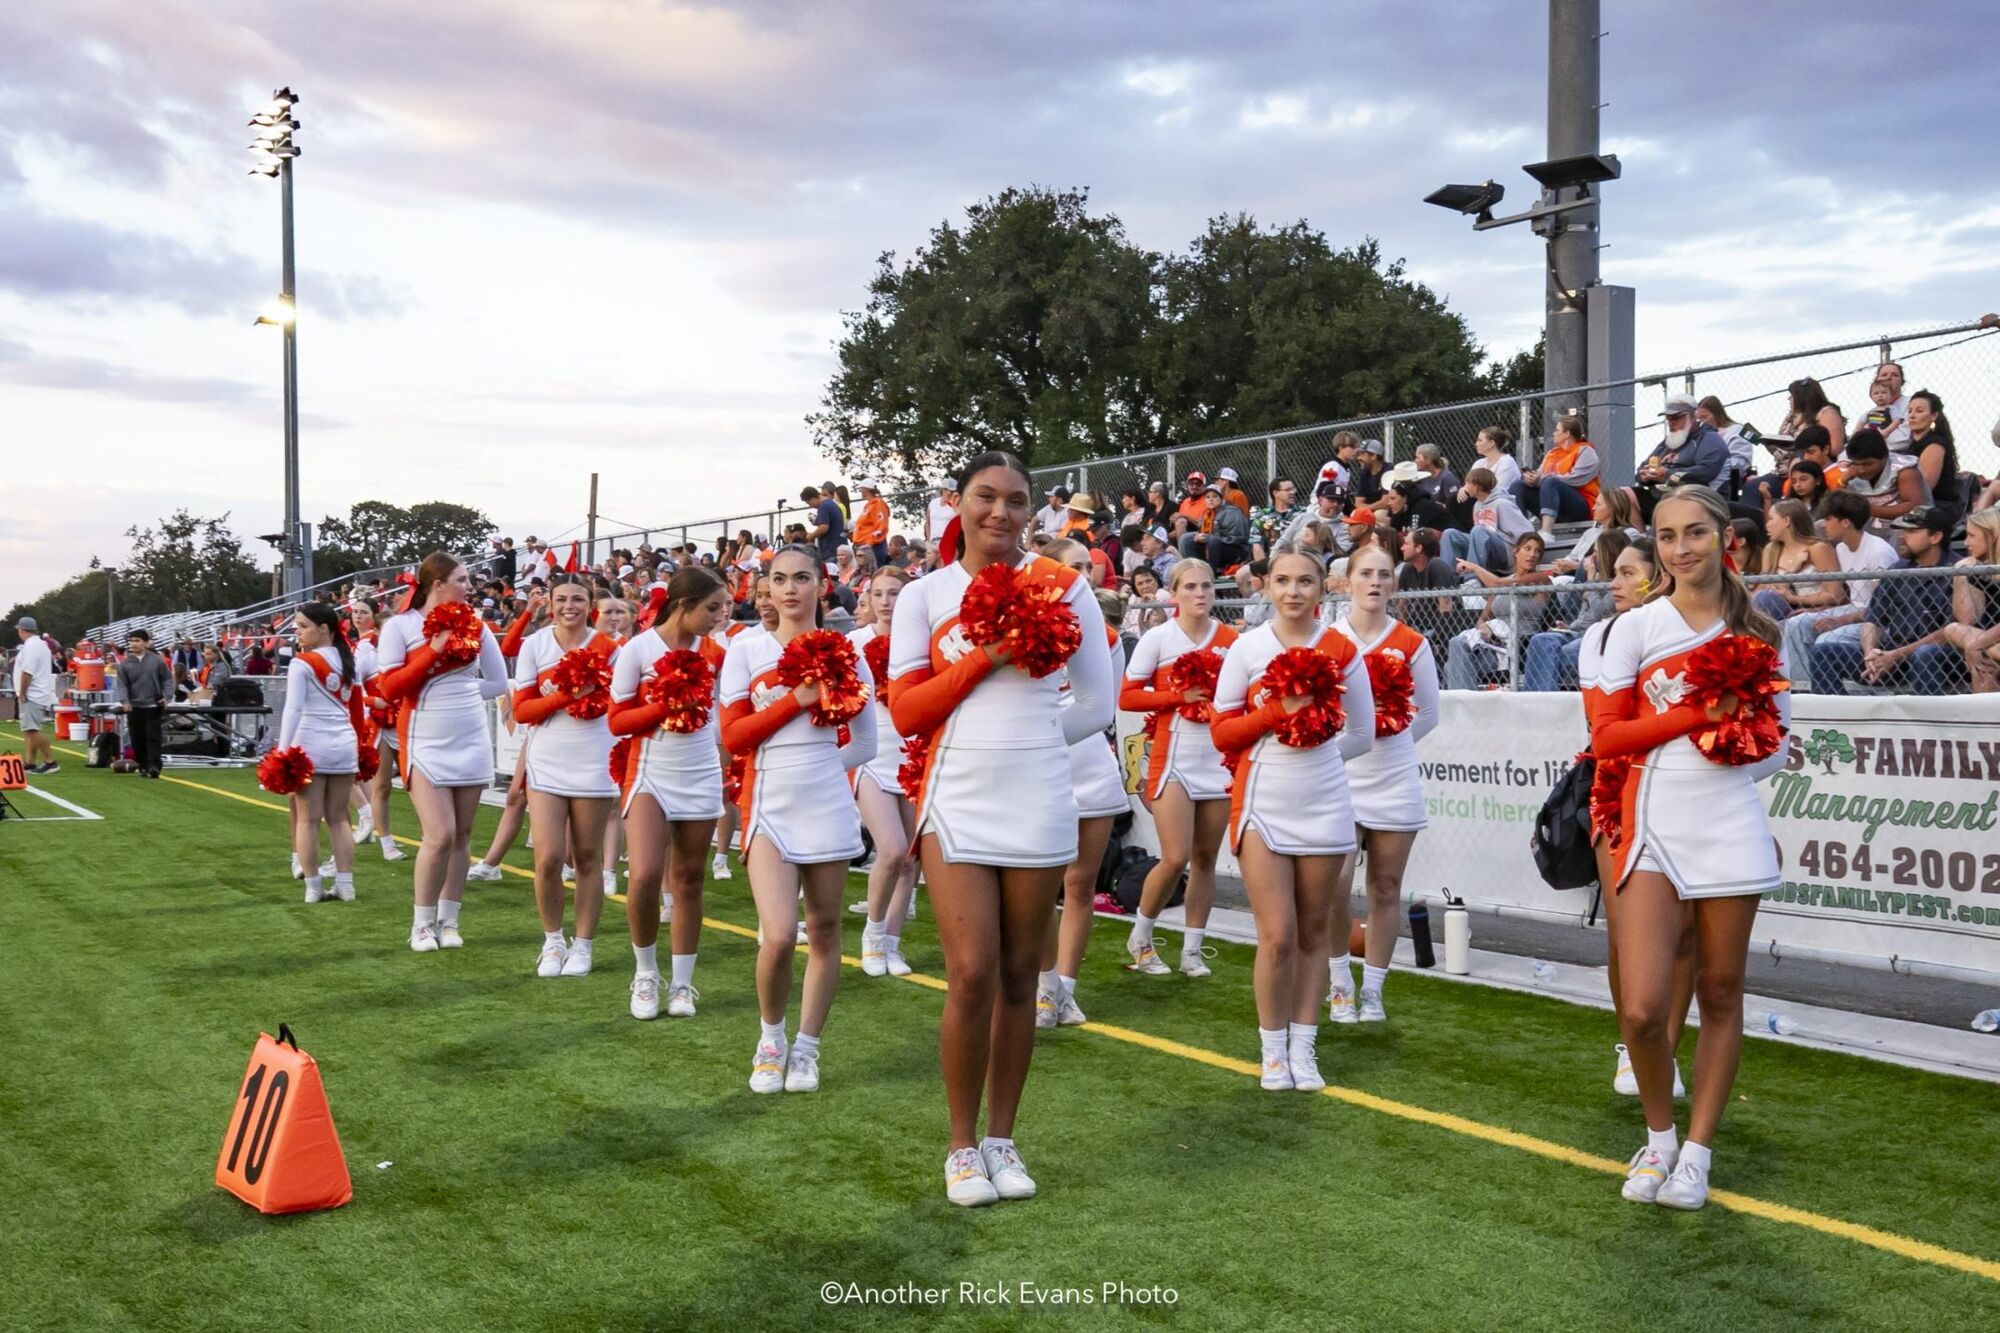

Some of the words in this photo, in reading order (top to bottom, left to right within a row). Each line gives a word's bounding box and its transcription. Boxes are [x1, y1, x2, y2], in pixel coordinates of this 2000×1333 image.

[0, 758, 25, 785] 30
[1418, 762, 1500, 785] vement
[1505, 759, 1539, 787] for
[1544, 760, 1569, 787] lif
[1853, 737, 2000, 782] FAMILY
[1425, 790, 1476, 819] sical
[1768, 770, 2000, 843] Management
[1799, 839, 2000, 895] 464-2002
[227, 1063, 289, 1186] 10
